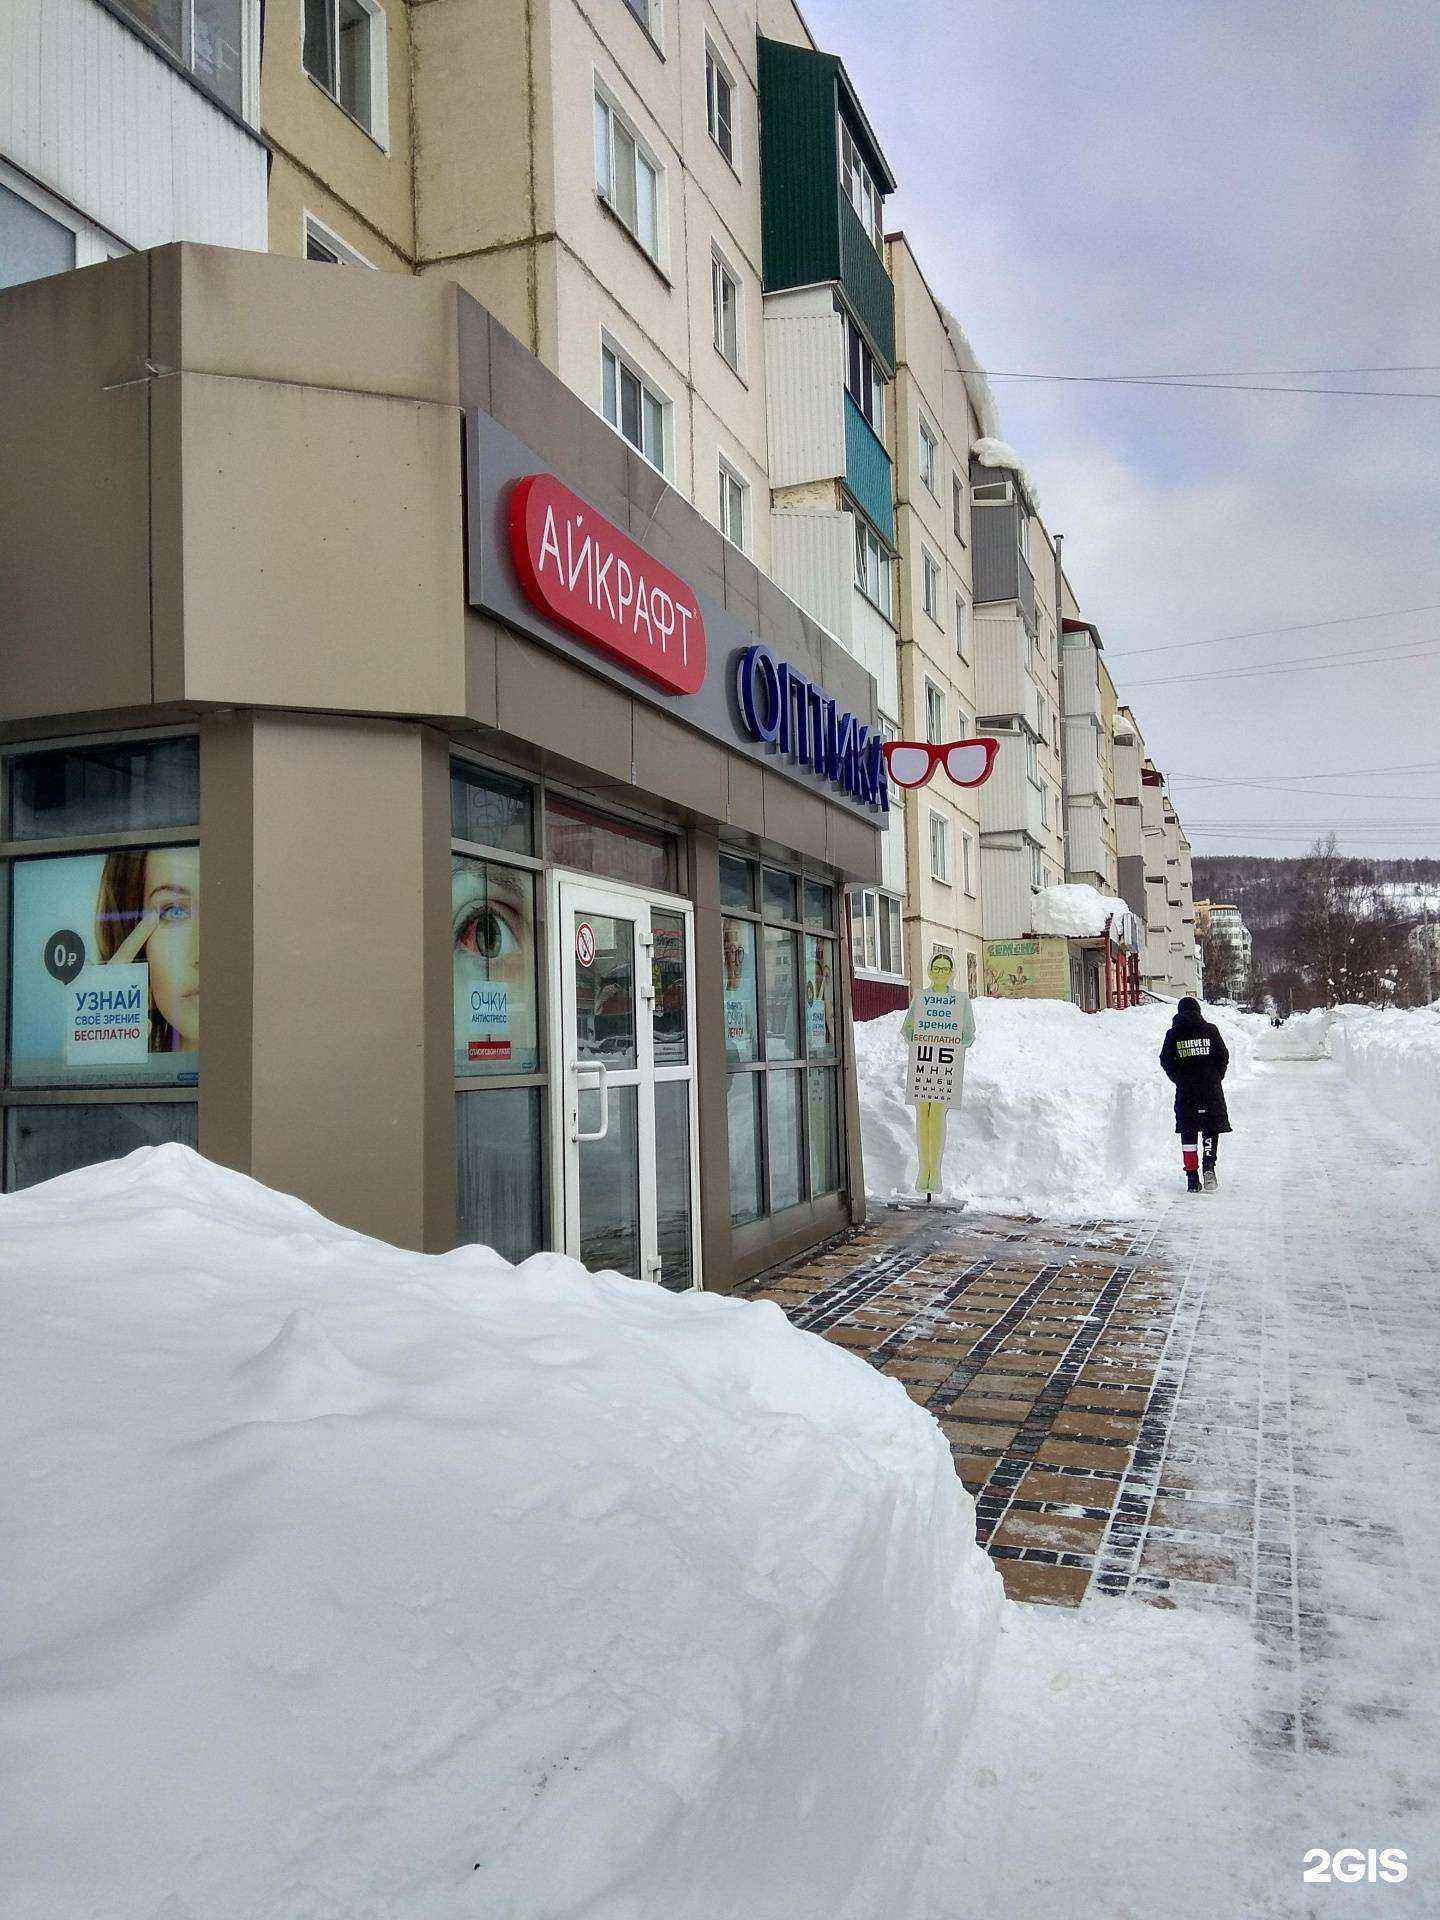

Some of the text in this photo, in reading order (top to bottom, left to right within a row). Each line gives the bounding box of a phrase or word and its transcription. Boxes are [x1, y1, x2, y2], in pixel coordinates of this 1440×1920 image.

[538, 504, 693, 668] АЙКРАФТ
[736, 644, 890, 813] ОПТИКА
[75, 984, 141, 1012] УЗНАЙ
[471, 990, 508, 1012] ОЧКИ
[924, 995, 956, 1006] узнай
[74, 1012, 140, 1026] СВОЁ ЗРЕНИЕ
[471, 1013, 508, 1024] АНТИСТРЕСС
[926, 1009, 952, 1018] свое
[918, 1020, 958, 1031] зрение
[74, 1028, 140, 1041] БЕСПЛАТНО
[913, 1033, 961, 1045] БЕСПЛАТНО
[1176, 1038, 1211, 1050] BELIEVE IN
[1178, 1047, 1210, 1058] YOURSELF
[1204, 1137, 1213, 1157] FILA
